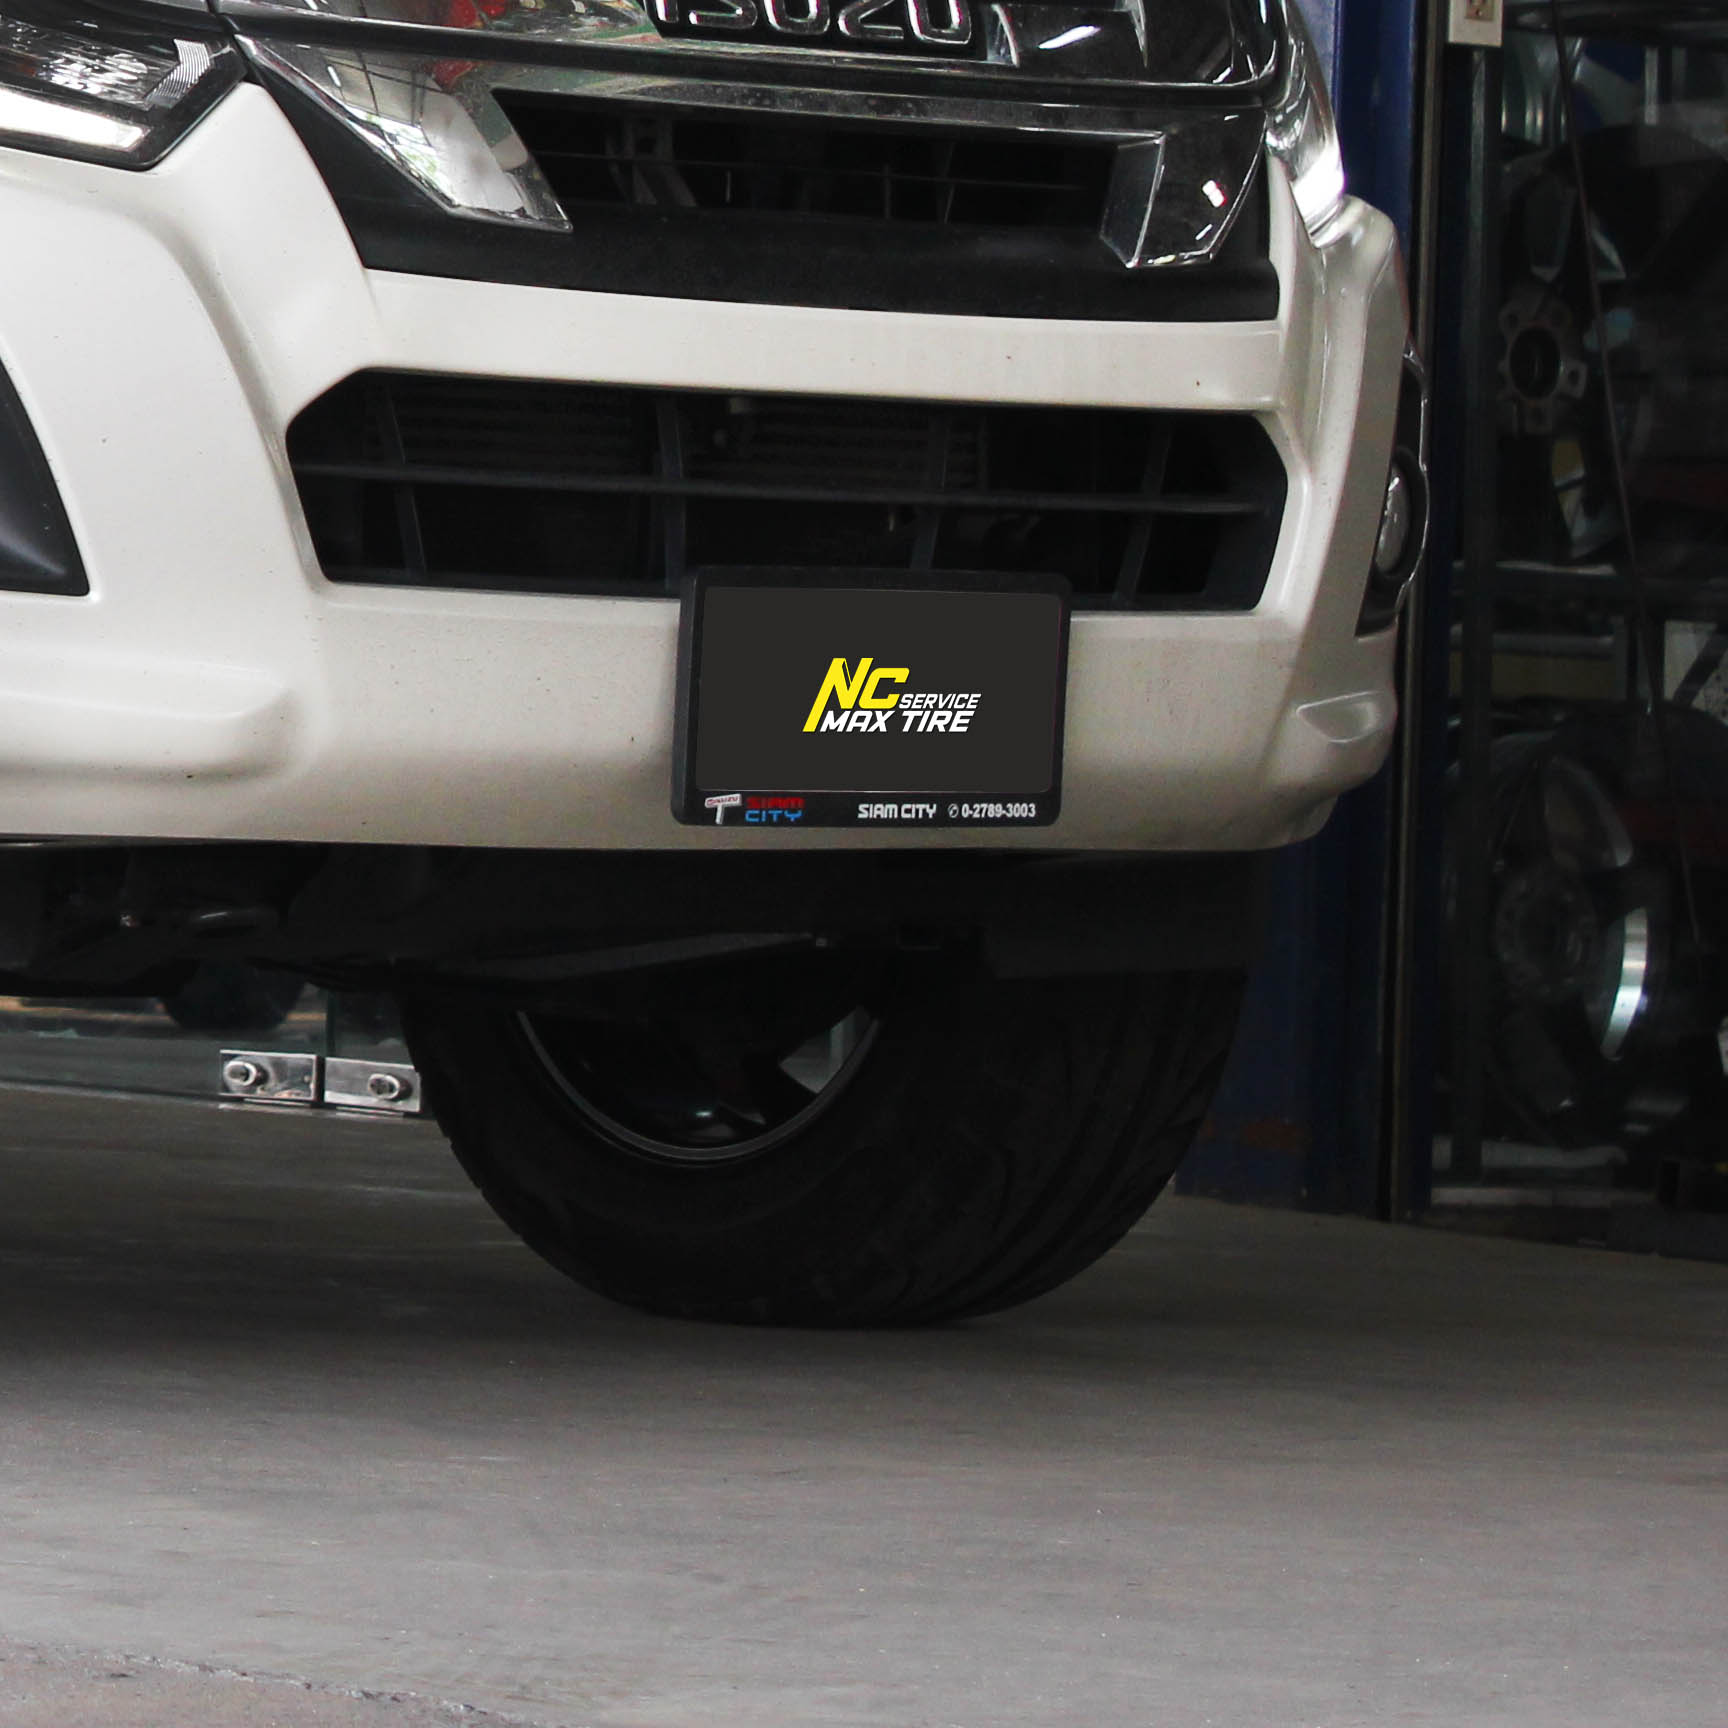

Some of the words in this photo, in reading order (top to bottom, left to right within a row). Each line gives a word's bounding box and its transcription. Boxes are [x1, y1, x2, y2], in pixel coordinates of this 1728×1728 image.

[746, 797, 804, 808] SIAM
[745, 810, 802, 822] CITY
[857, 803, 898, 819] SIAM
[901, 803, 937, 819] CITY
[961, 803, 1036, 818] 0-2789-3003
